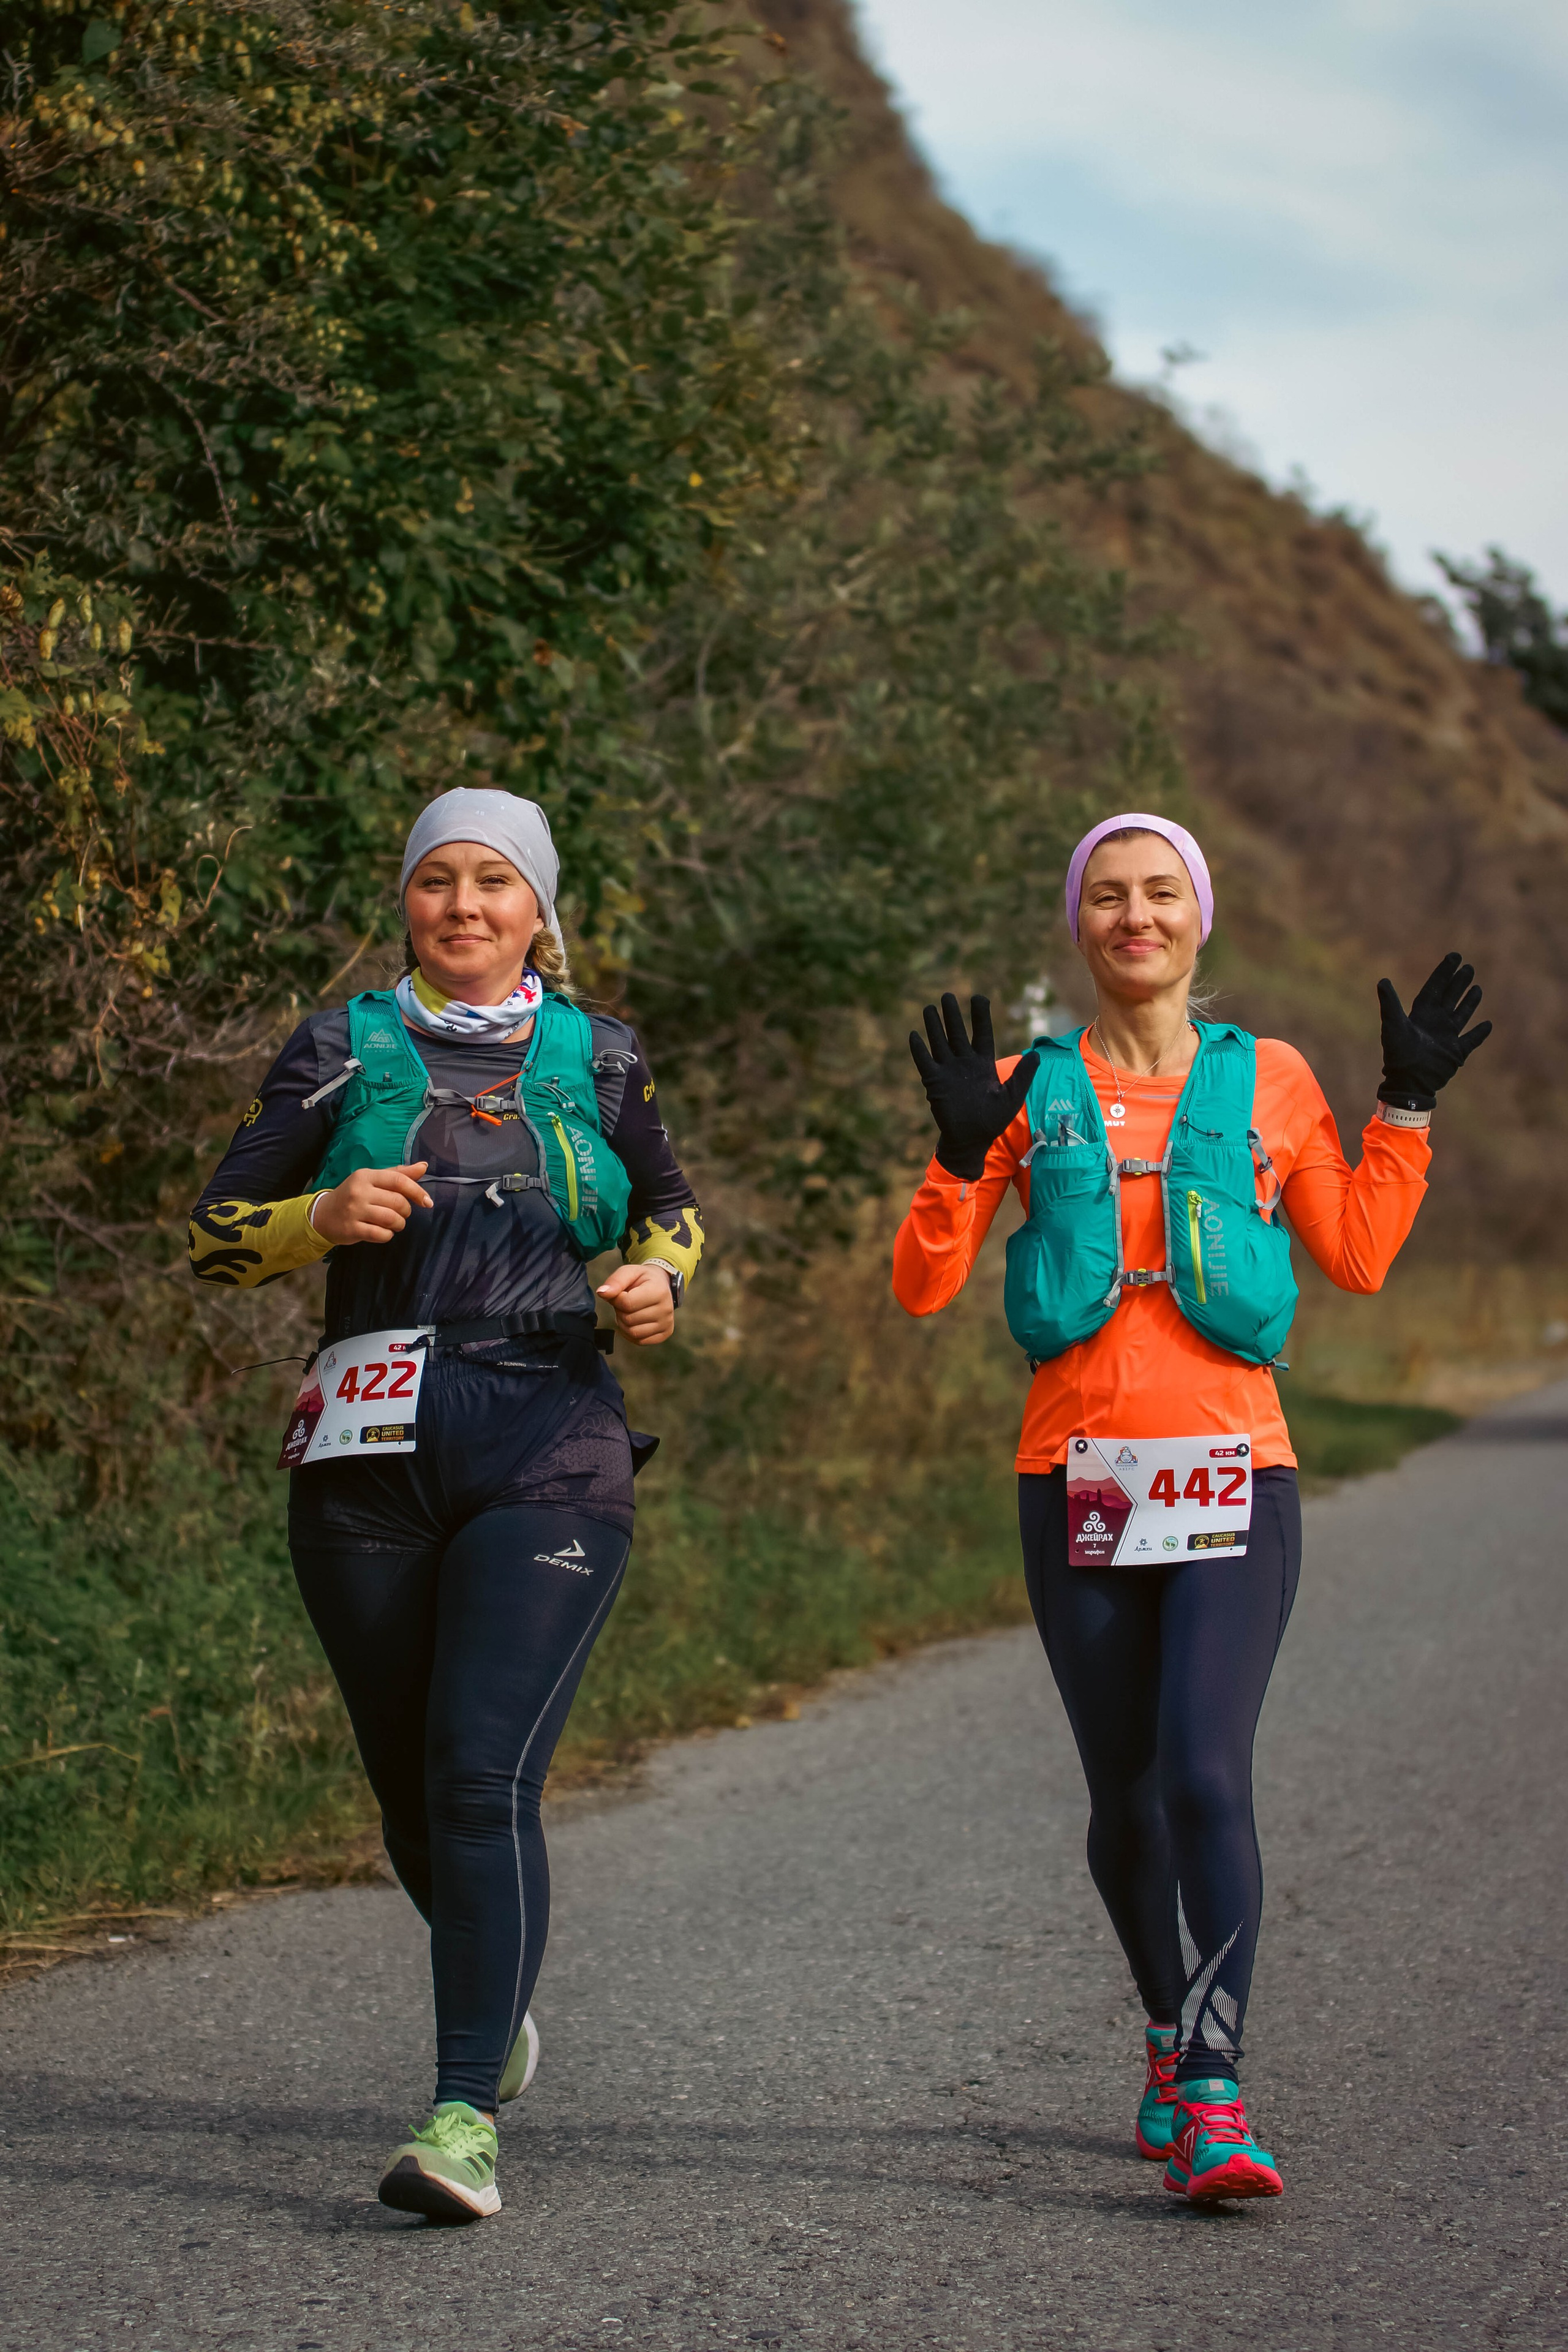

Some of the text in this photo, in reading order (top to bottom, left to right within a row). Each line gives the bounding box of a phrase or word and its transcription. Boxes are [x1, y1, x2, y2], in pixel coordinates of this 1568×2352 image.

[566, 1125, 598, 1217] AONIJIE
[1203, 1197, 1229, 1297] AONIJIE
[336, 1361, 417, 1404] 422
[1148, 1467, 1247, 1507] 442
[1076, 1533, 1114, 1543] ДЖЕЙРАХ
[533, 1554, 594, 1576] DEMIX
